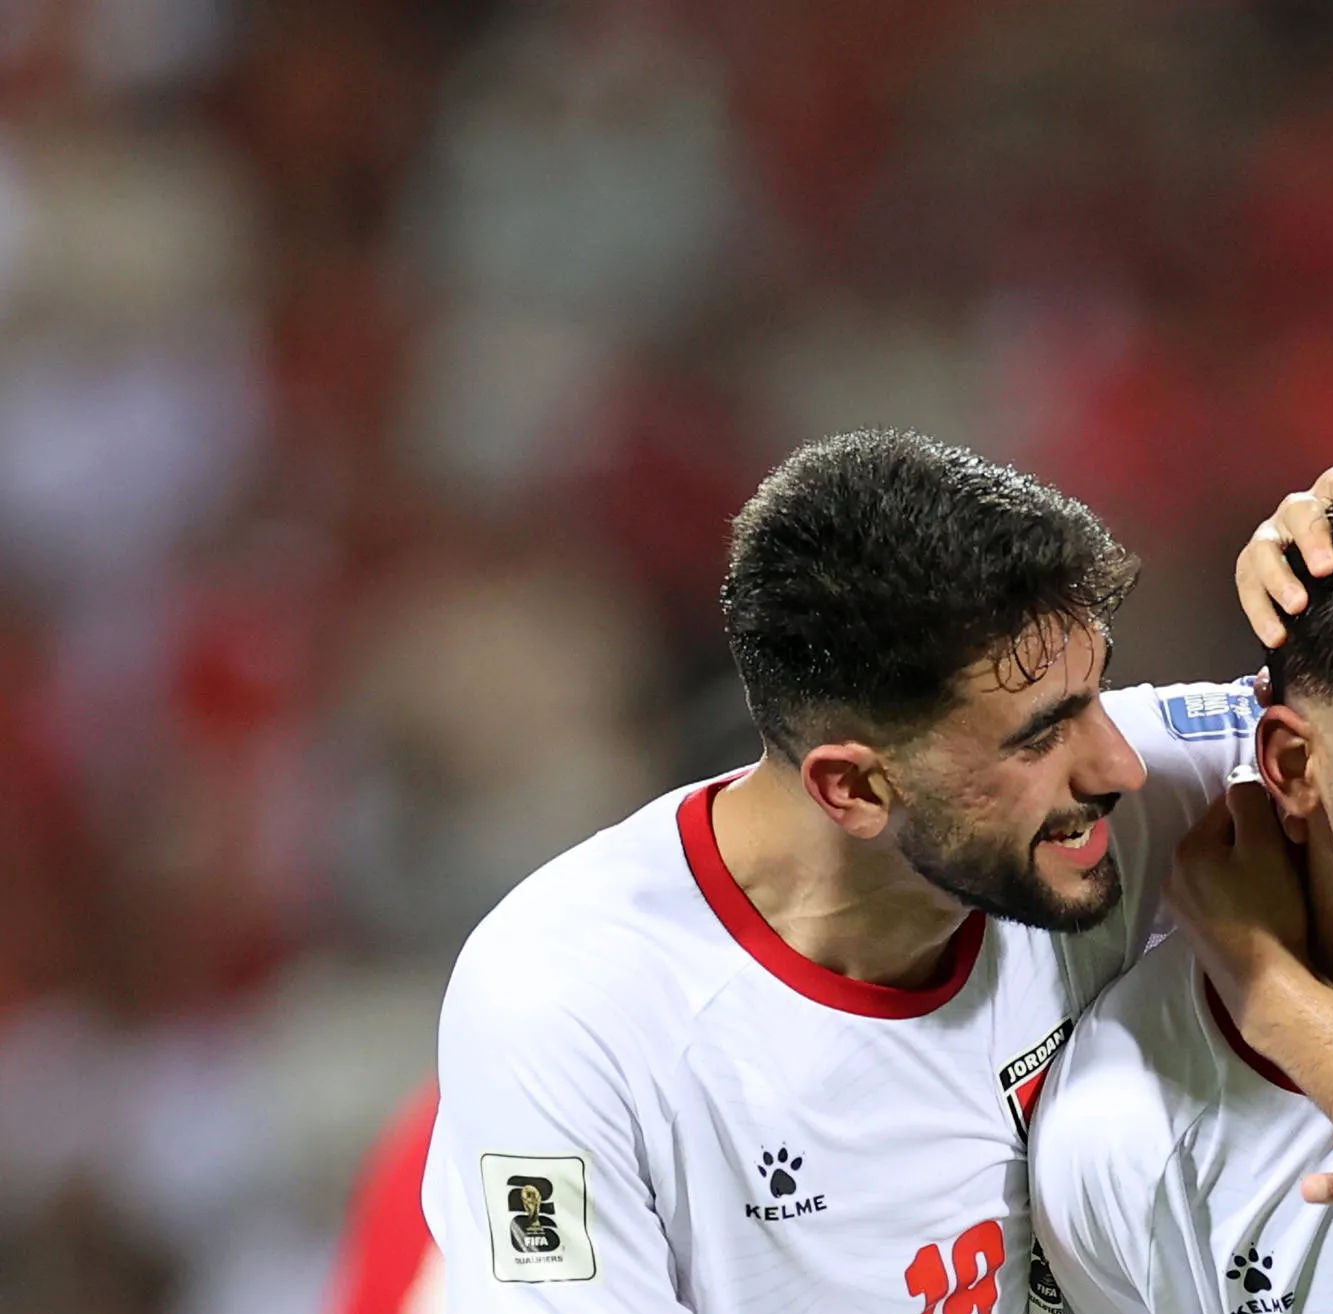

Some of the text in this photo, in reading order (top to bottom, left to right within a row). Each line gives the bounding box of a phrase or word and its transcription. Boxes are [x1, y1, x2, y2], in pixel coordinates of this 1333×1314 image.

[1006, 1027, 1066, 1084] JORDAN
[744, 1194, 828, 1222] KELME
[524, 1236, 549, 1247] FIFA
[1036, 1282, 1058, 1298] FIFA
